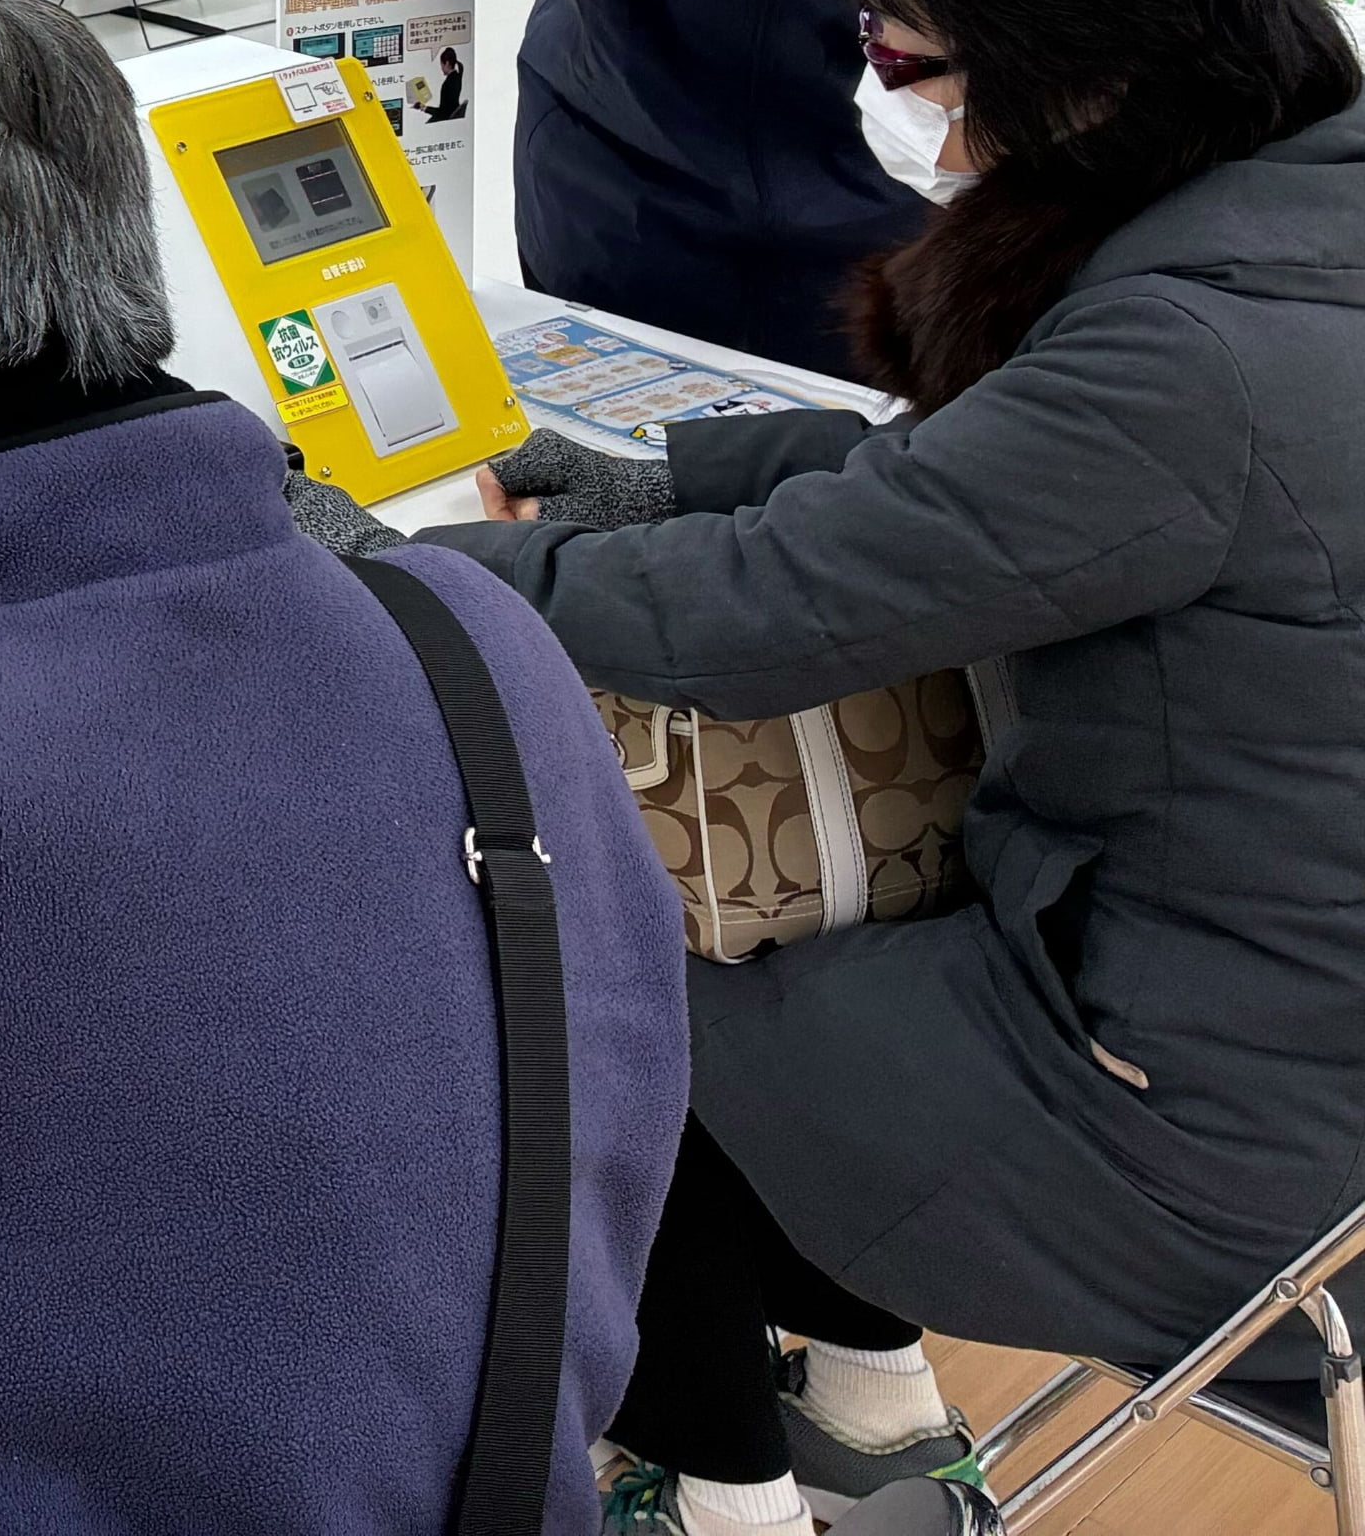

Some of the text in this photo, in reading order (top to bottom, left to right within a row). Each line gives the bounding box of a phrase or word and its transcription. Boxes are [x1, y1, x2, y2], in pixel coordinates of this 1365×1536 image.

[276, 323, 300, 343] 抗菌
[270, 334, 319, 361] 抗ウィルス
